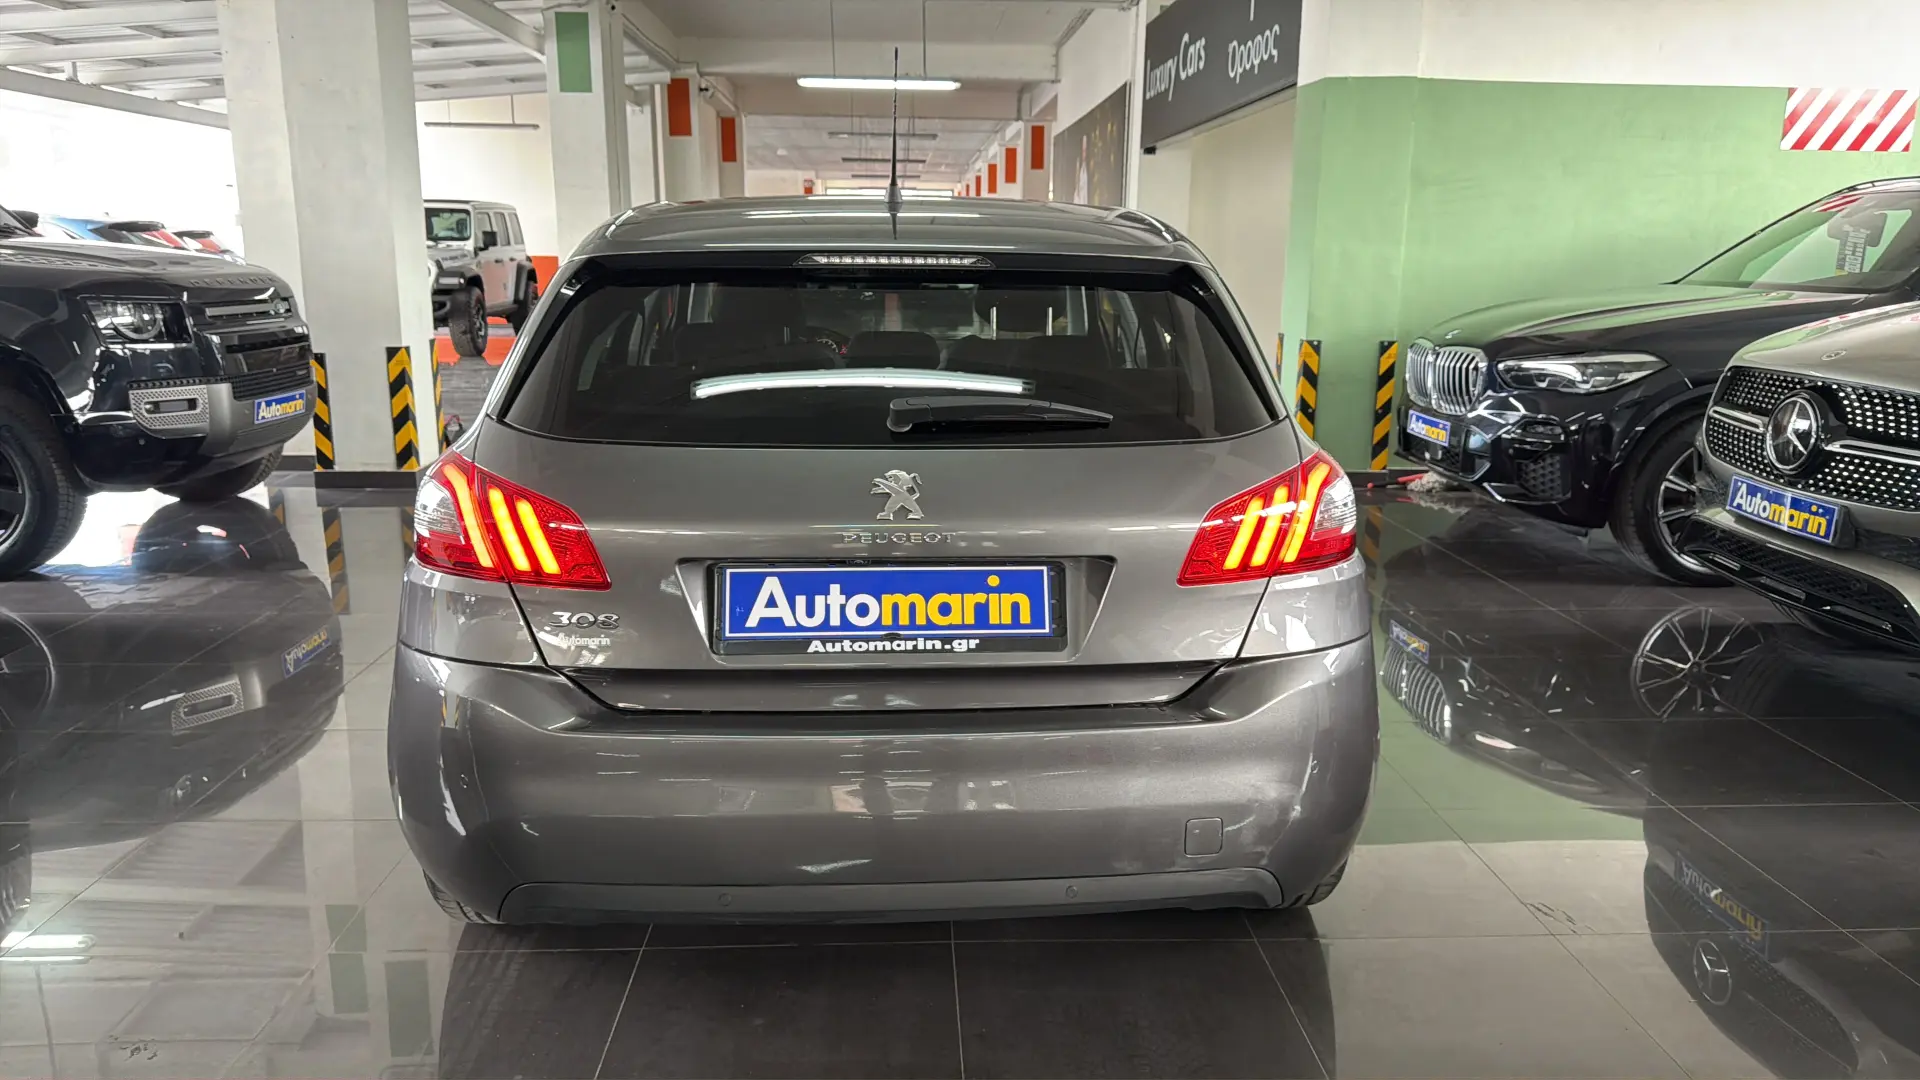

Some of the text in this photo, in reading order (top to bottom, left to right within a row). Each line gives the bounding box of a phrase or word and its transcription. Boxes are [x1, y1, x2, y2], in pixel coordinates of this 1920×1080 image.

[1146, 32, 1206, 102] Luxury Cars
[258, 394, 304, 420] Automarin
[1733, 483, 1828, 537] Automarin
[842, 532, 956, 544] PEUGEOT
[745, 574, 1031, 628] Automarin
[549, 611, 620, 629] 308
[807, 638, 980, 653] Automarin.gr
